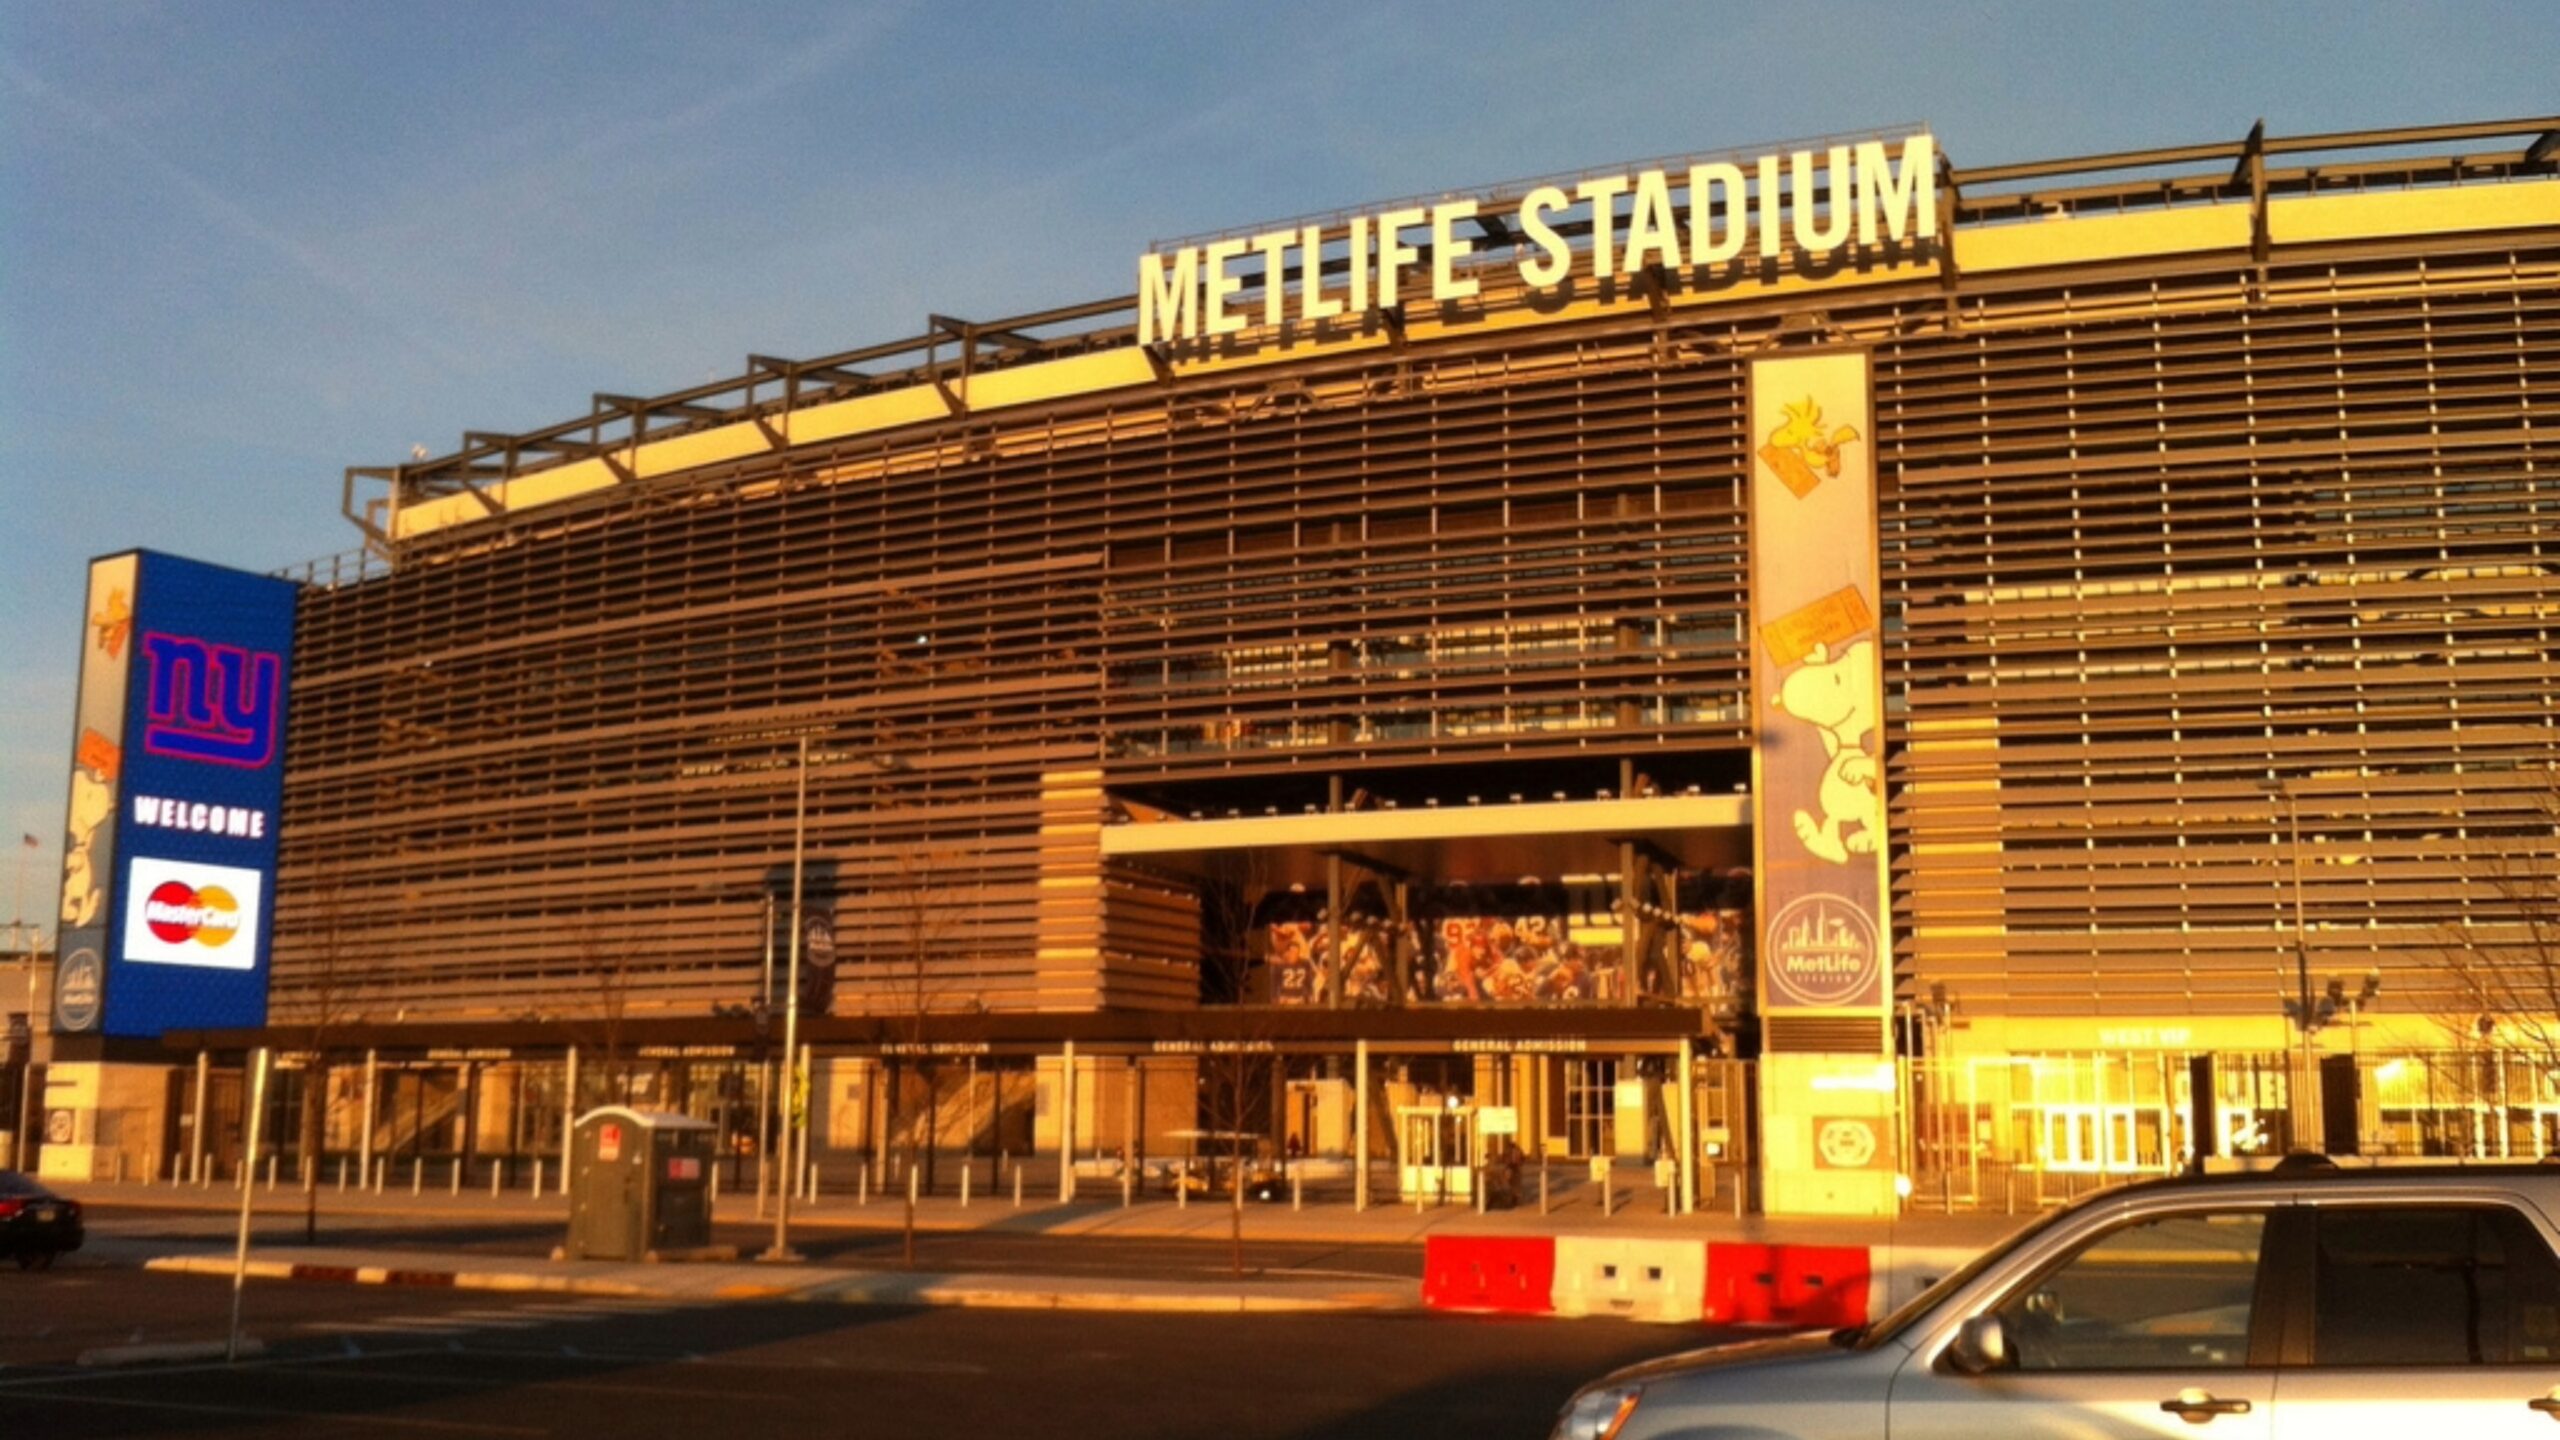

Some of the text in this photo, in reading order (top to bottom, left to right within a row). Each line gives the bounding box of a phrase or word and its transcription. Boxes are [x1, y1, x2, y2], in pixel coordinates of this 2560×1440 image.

[1137, 134, 1938, 346] METLIFE STADIUM
[134, 795, 265, 838] WELCOME
[1786, 953, 1861, 973] MetLife
[1453, 1039, 1586, 1052] GENERAL ADMISSION
